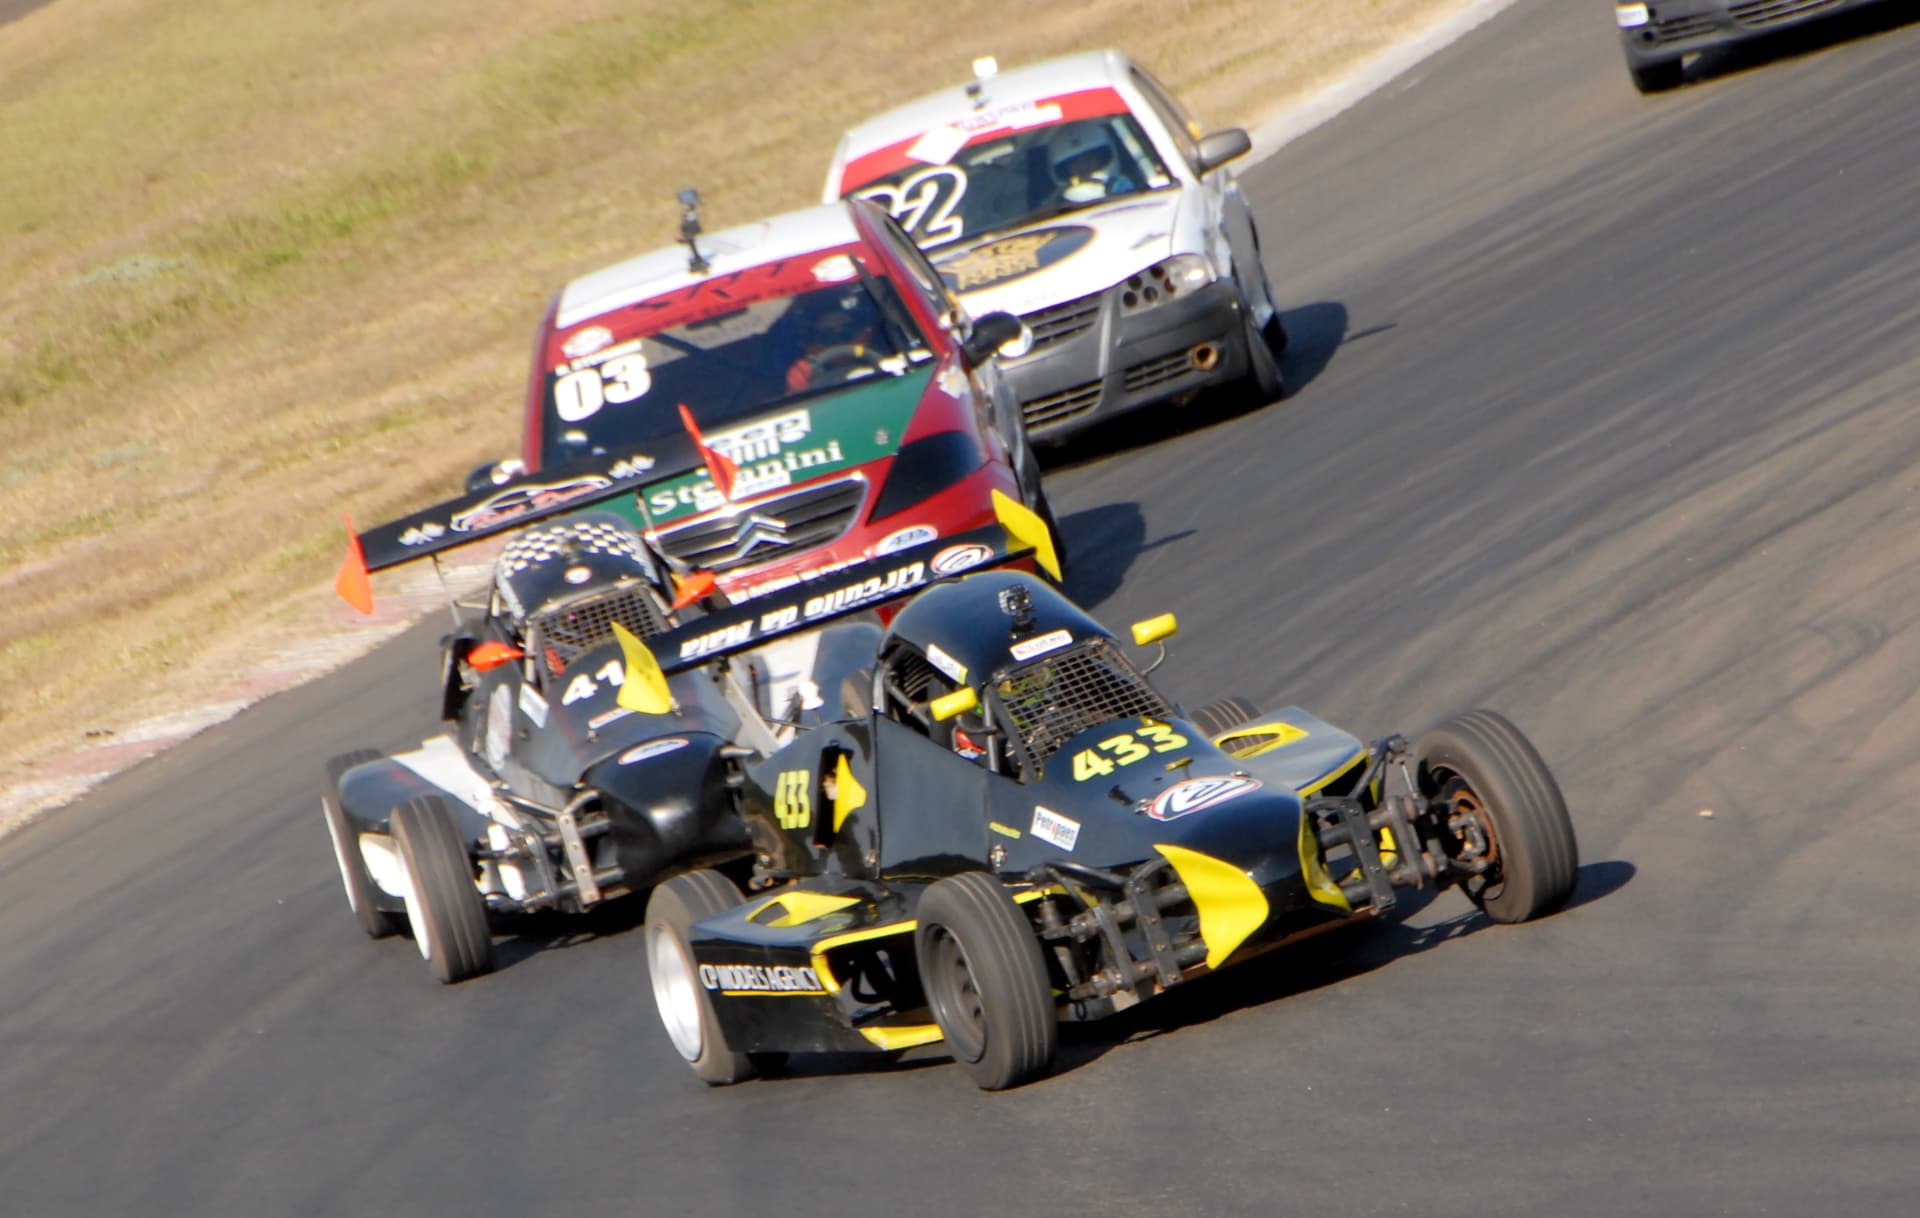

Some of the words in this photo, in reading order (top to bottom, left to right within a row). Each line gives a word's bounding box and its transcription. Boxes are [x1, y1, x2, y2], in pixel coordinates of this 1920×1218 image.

[553, 353, 652, 422] 03
[650, 440, 845, 517] Steanini
[561, 659, 625, 706] 41
[1073, 723, 1189, 783] 433
